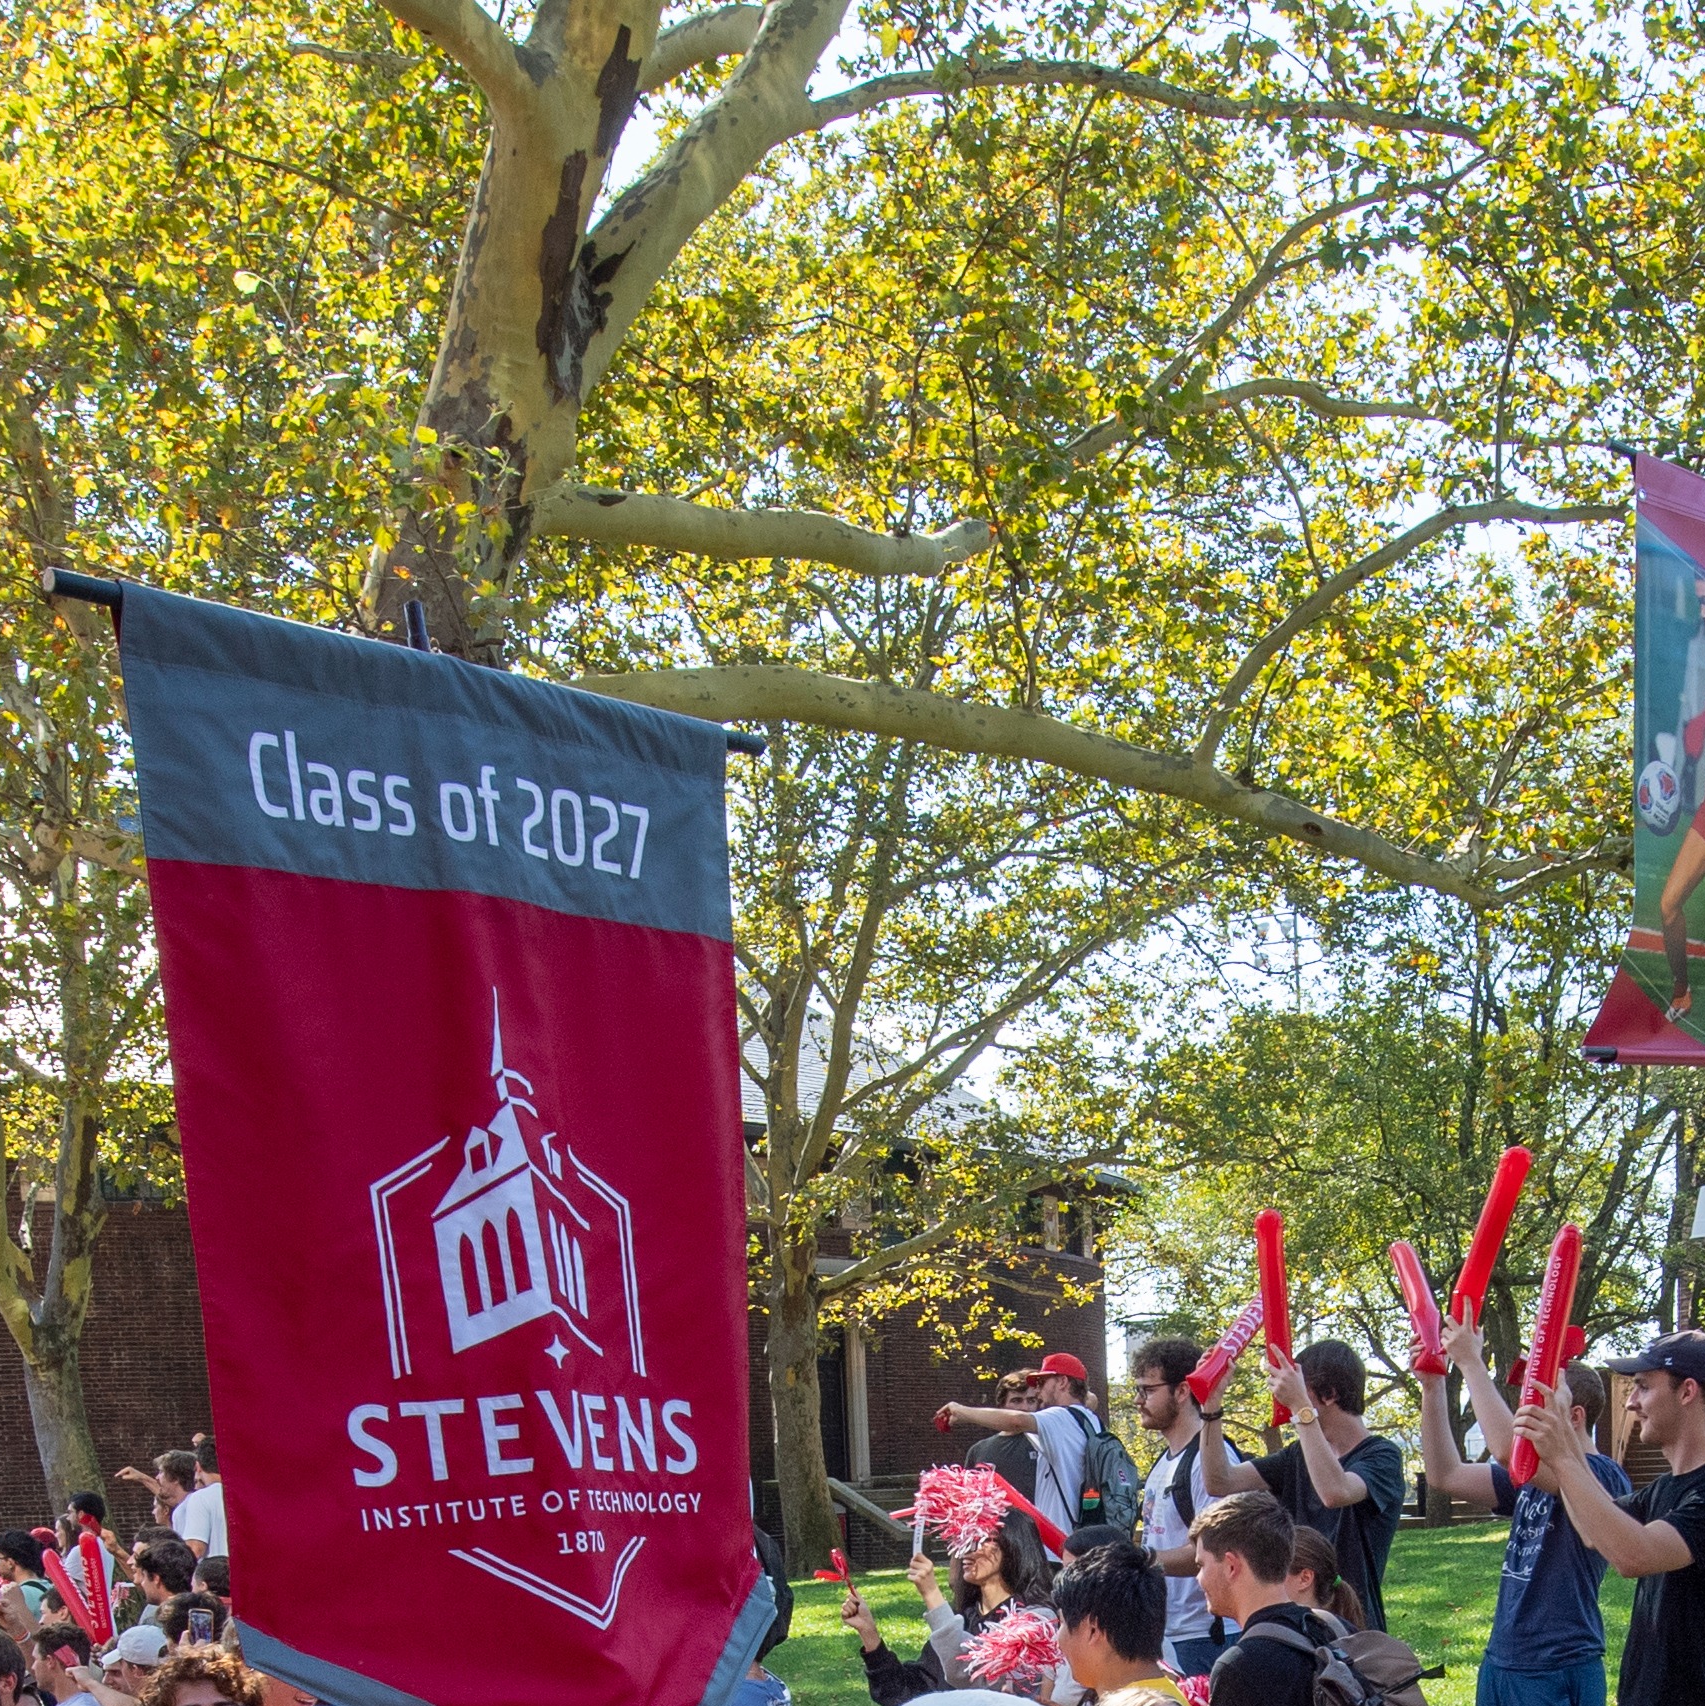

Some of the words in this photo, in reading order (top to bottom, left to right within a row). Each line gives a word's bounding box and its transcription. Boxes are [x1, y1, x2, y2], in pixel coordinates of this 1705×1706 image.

[248, 729, 417, 837] Class
[439, 764, 500, 847] of
[516, 776, 650, 880] 2027
[1536, 1329, 1547, 1343] OF
[1543, 1256, 1563, 1326] TECHNOLOGY
[346, 1390, 699, 1488] STEVENS
[360, 1494, 527, 1532] INSTITUTE
[541, 1488, 582, 1514] OF
[586, 1488, 702, 1514] TECHNOLOGY
[557, 1530, 606, 1556] 1870
